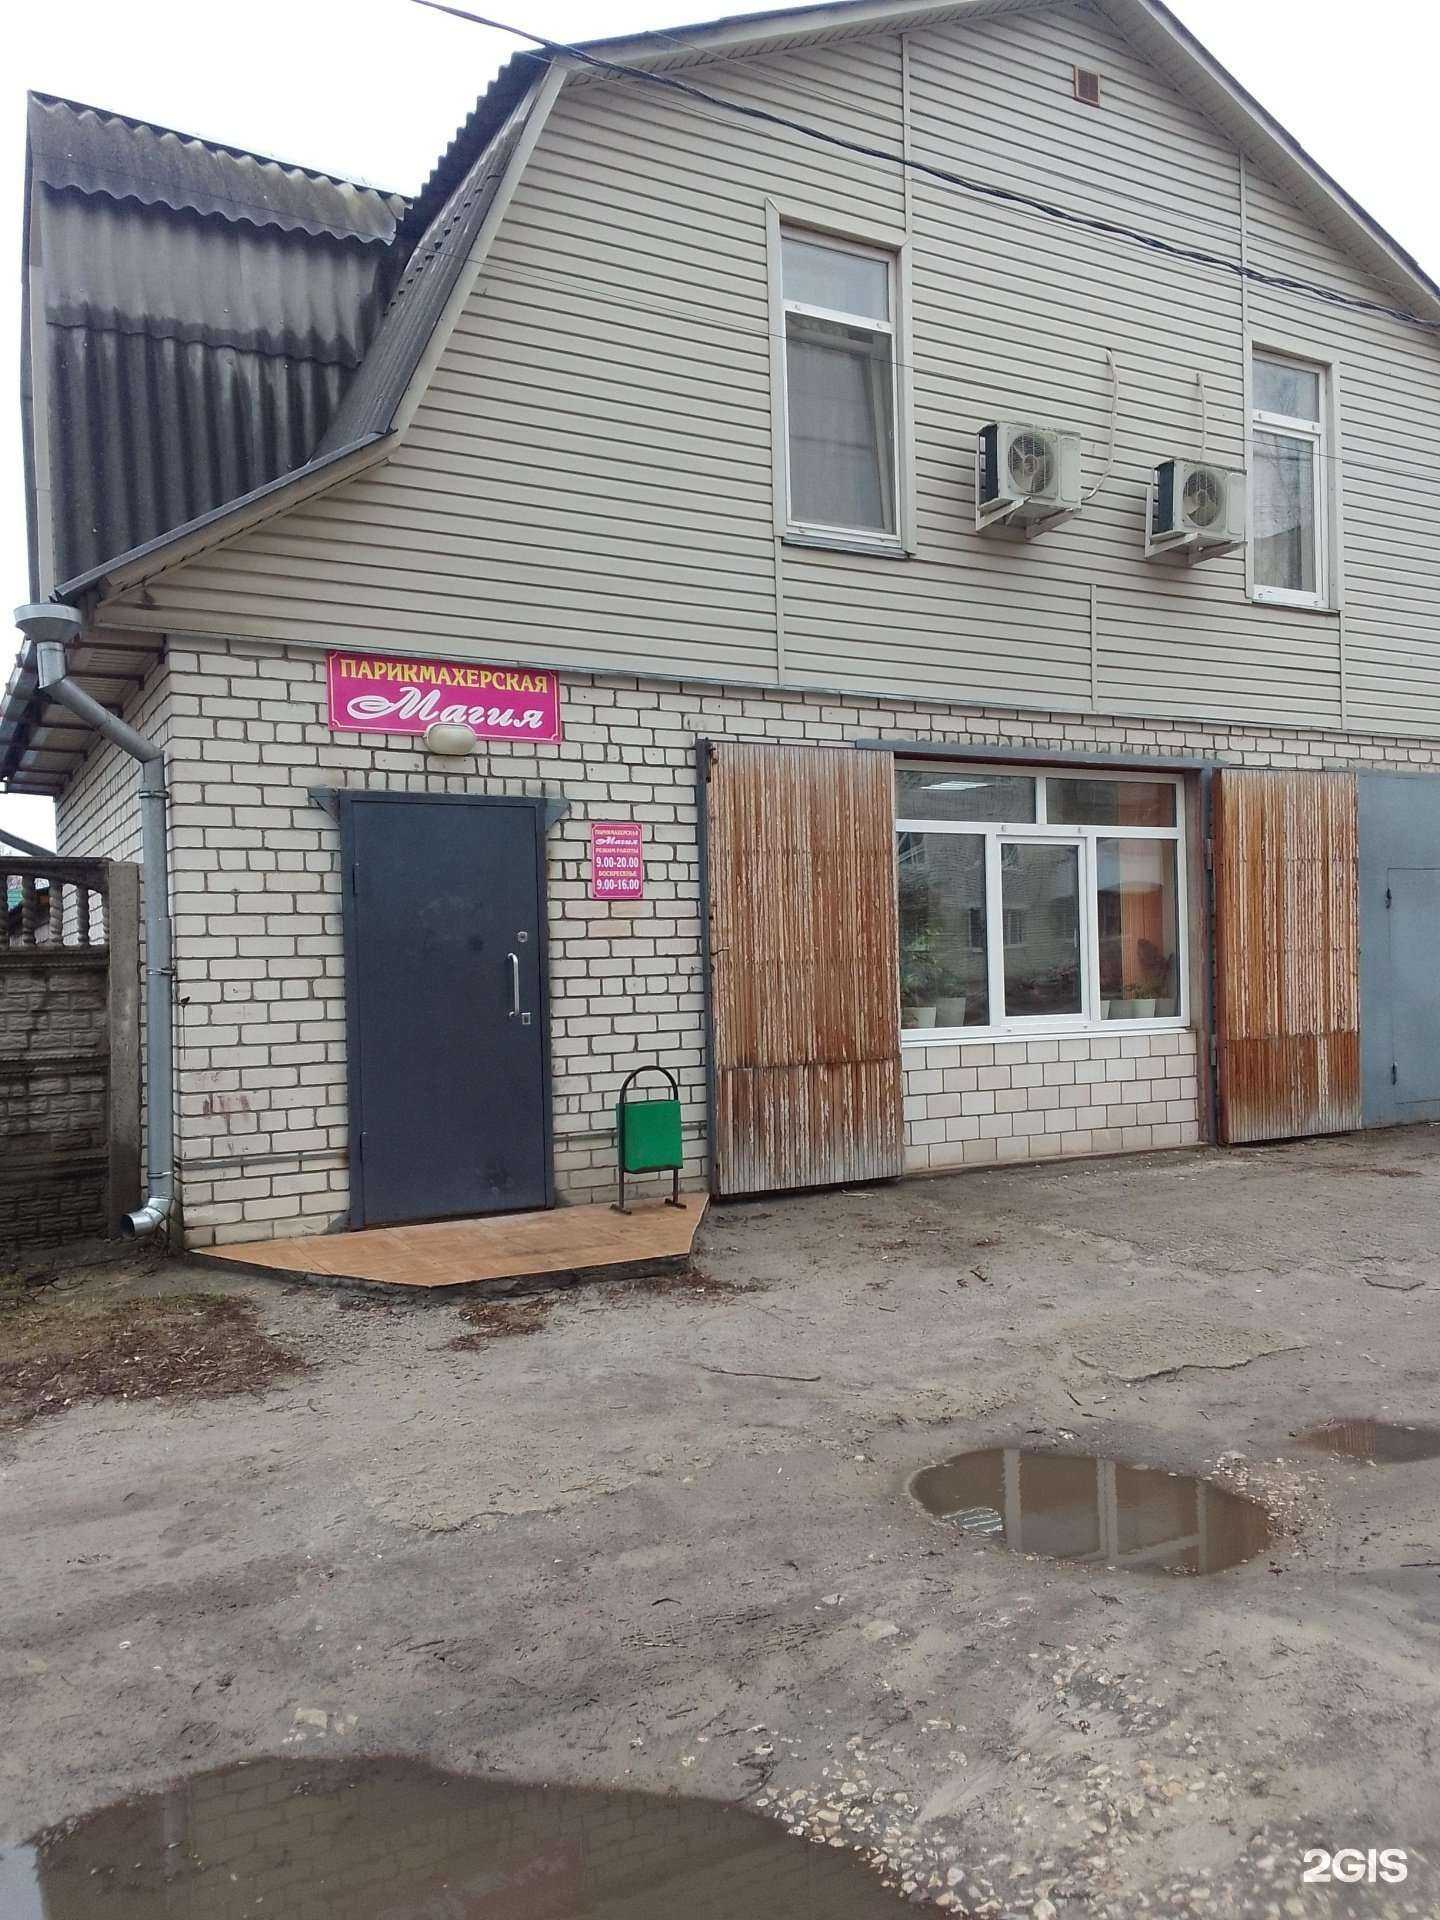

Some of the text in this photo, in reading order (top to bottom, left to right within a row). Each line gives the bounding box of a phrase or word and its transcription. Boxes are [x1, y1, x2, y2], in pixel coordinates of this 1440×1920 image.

[340, 658, 548, 694] ПАРИКМАХЕРСКАЯ
[346, 686, 544, 729] Магия
[595, 836, 639, 845] Магия
[596, 856, 639, 868] 9.00-20.00
[596, 879, 639, 890] 9.00-16.00
